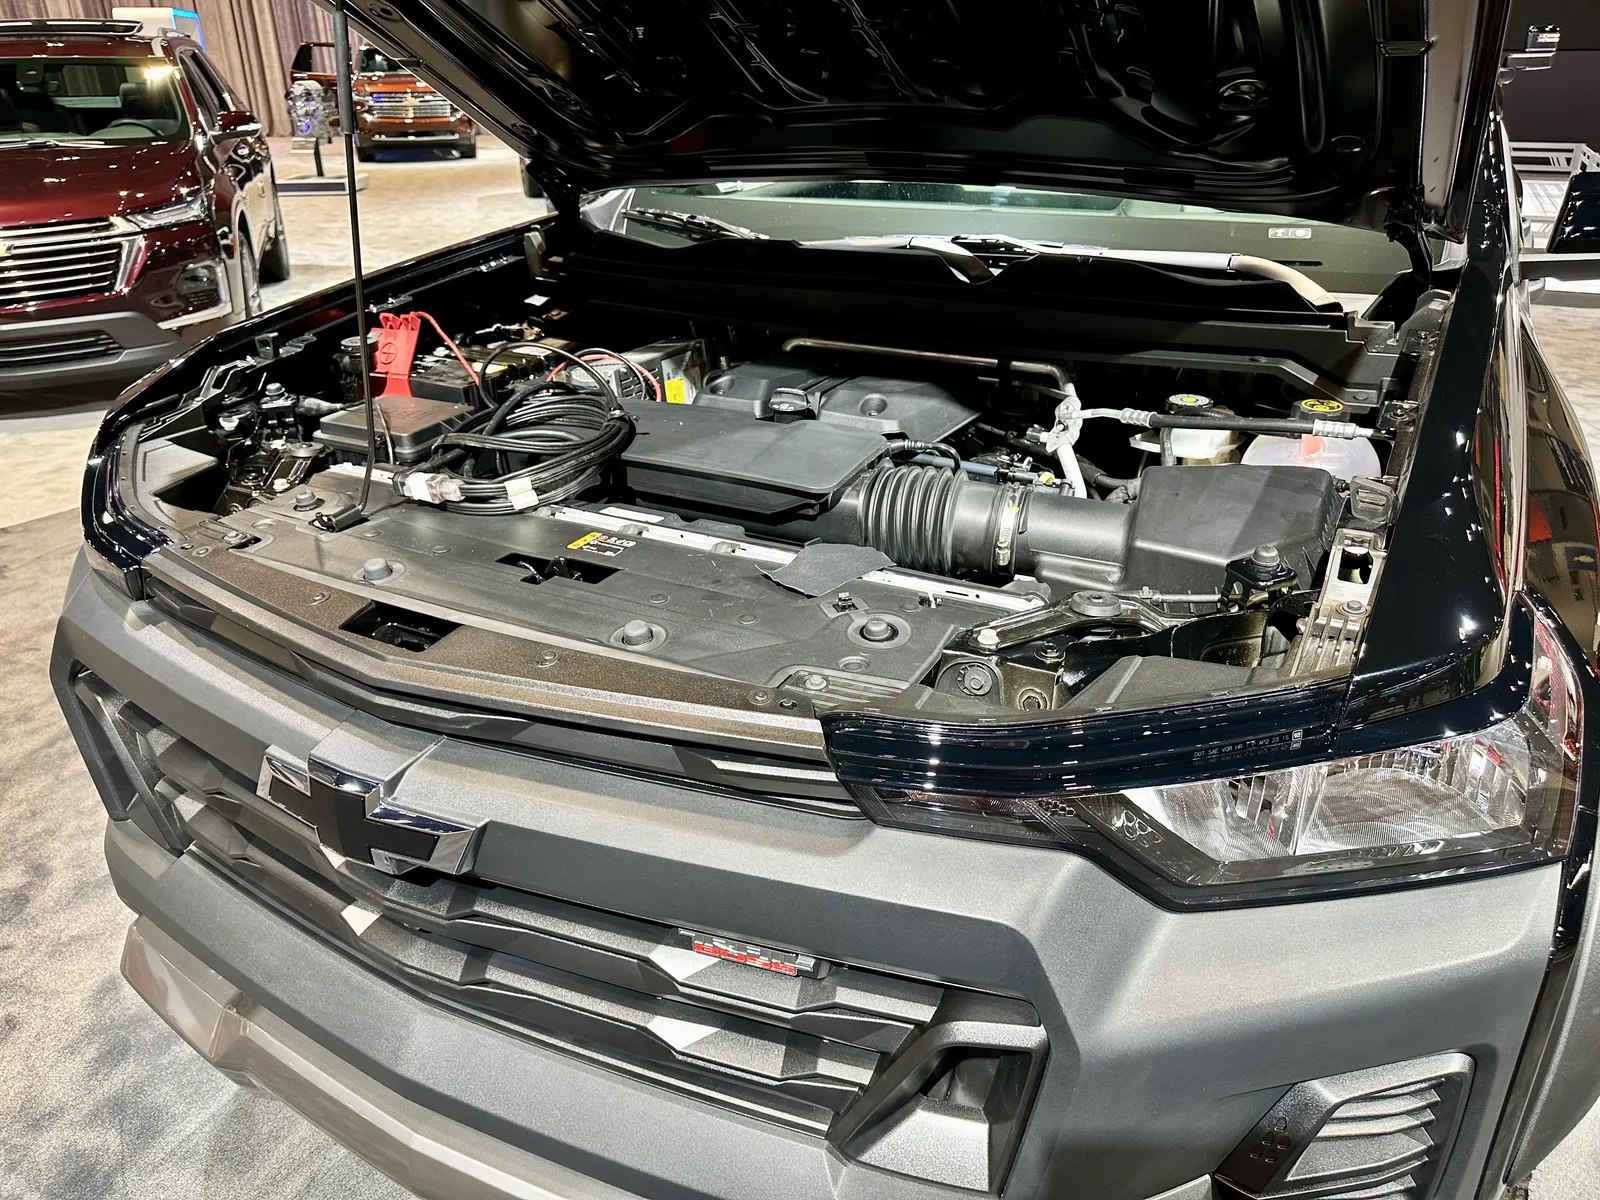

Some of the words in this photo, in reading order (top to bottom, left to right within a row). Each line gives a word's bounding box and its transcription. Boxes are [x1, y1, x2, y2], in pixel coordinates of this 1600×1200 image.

[1193, 750, 1205, 758] DOT
[1208, 747, 1220, 756] SAE
[1221, 745, 1233, 753] VOR
[693, 941, 798, 977] BOSS
